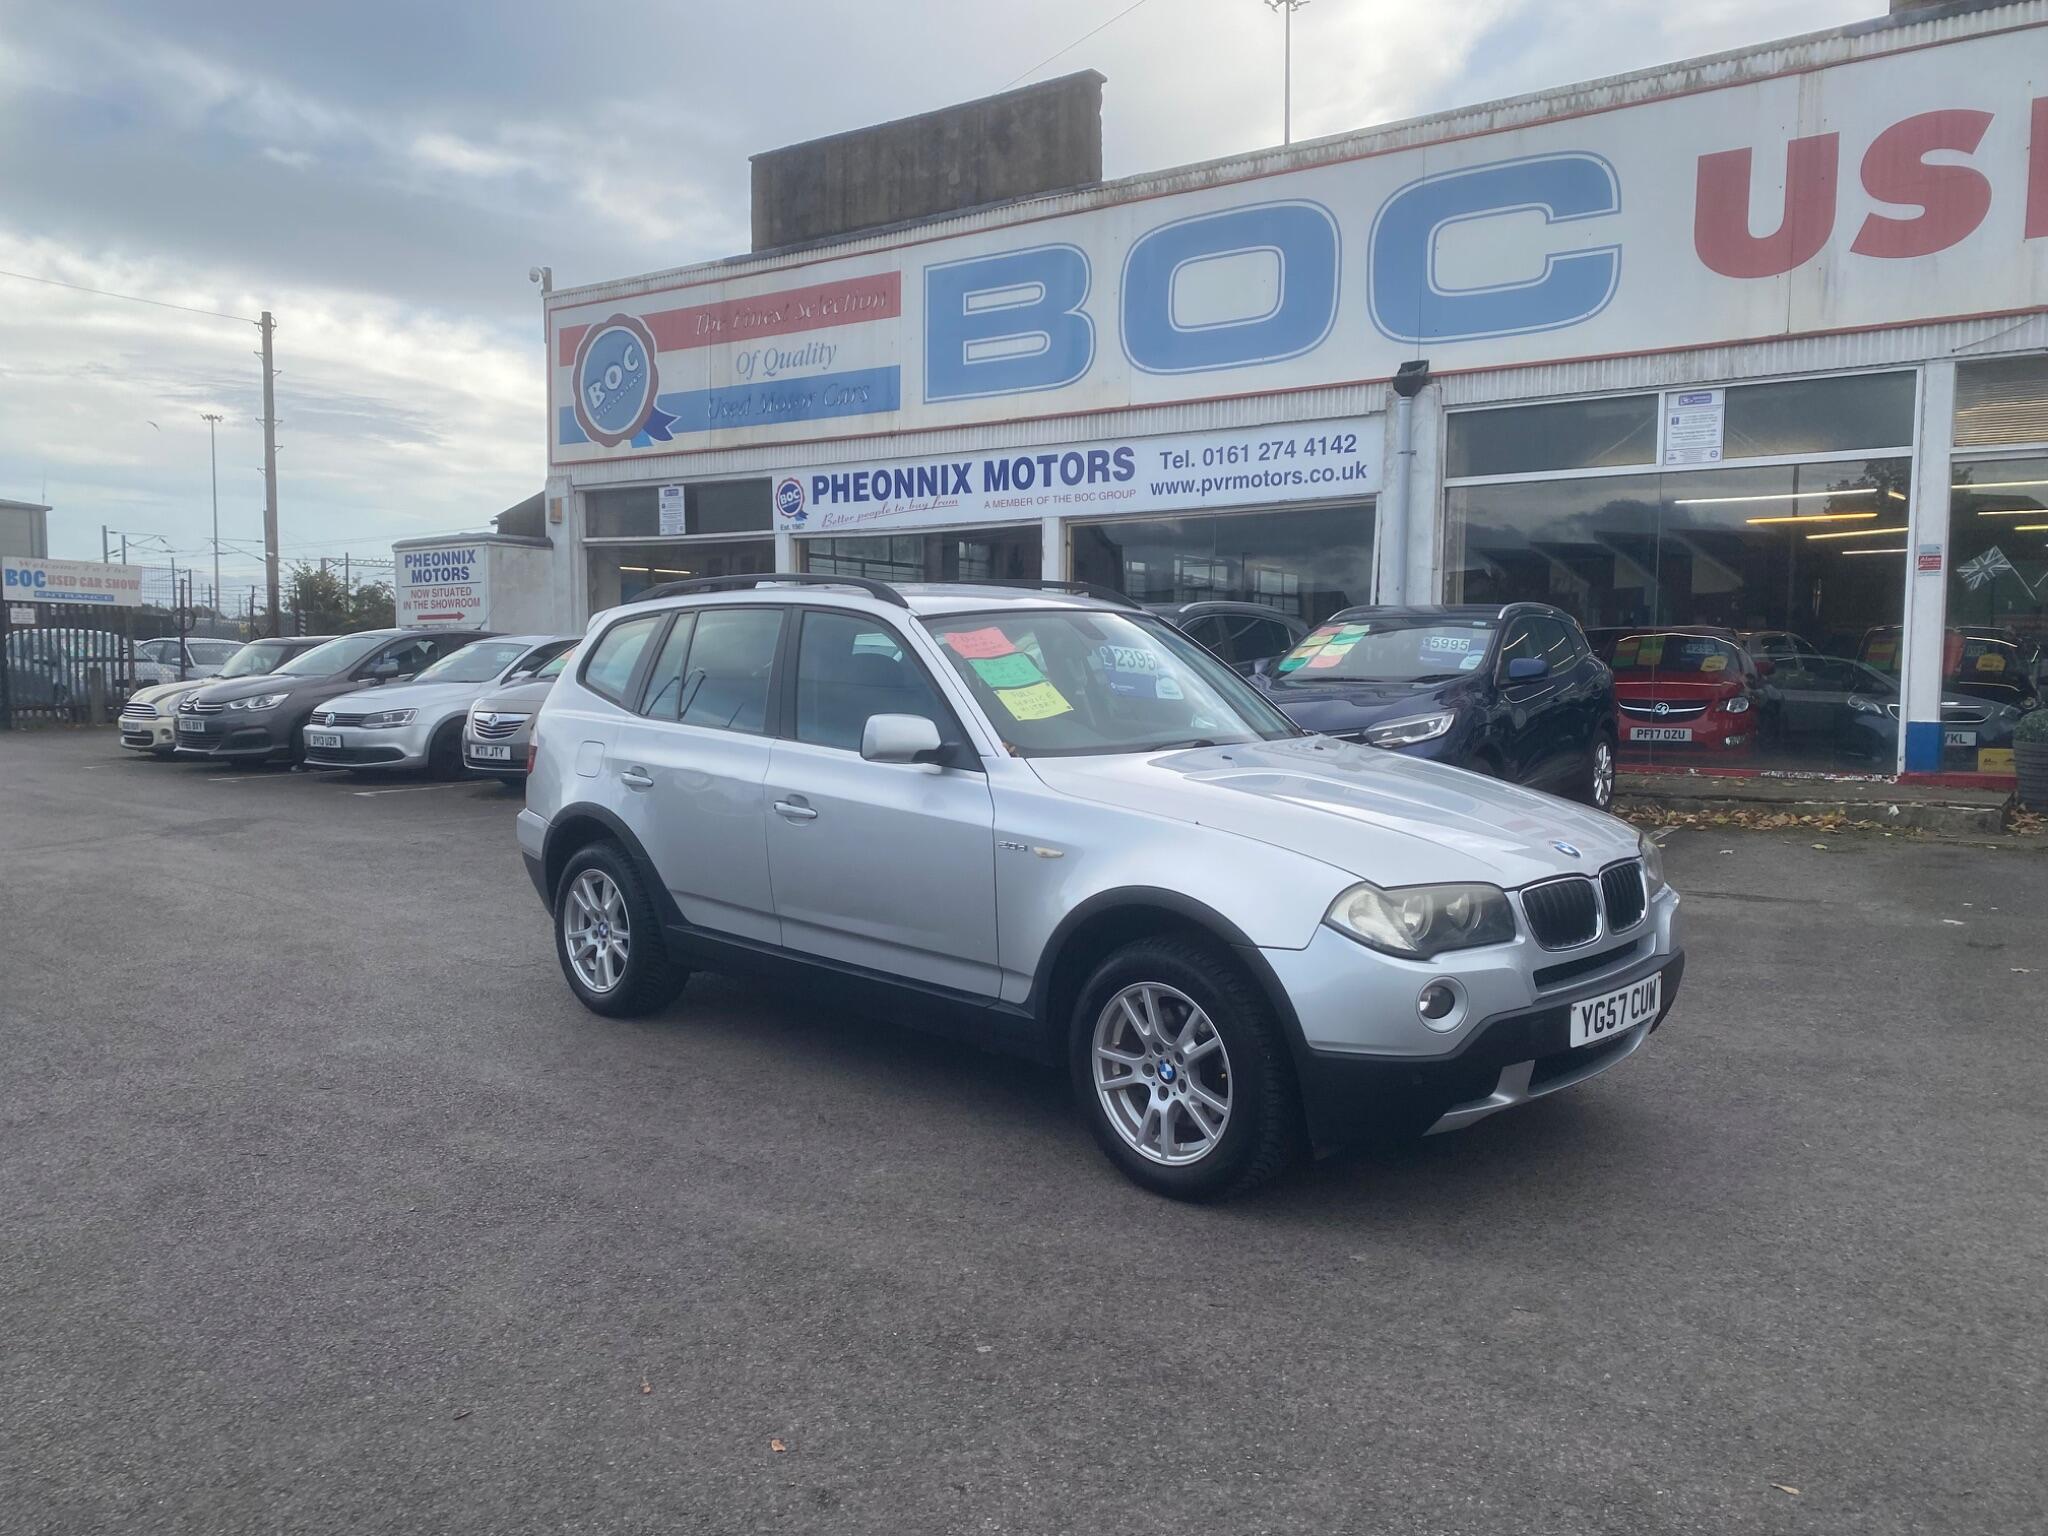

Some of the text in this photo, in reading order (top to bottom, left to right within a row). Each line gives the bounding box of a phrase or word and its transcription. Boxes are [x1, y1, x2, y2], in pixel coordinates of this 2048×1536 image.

[923, 96, 2048, 400] BOC US
[736, 342, 837, 380] Of Quality
[587, 344, 639, 409] BOC
[823, 382, 871, 408] Cars
[1160, 433, 1357, 470] Tel. 0161 274 4142
[812, 446, 1136, 505] PHEONNIX MOTORS
[1150, 460, 1368, 496] www.pvrmotors.co.uk
[780, 488, 800, 504] BOC
[984, 488, 1137, 509] A MEMBER OF THE BOC GROUP
[822, 511, 854, 528] Better
[856, 501, 891, 522] people
[894, 503, 905, 512] to
[931, 495, 959, 510] from
[404, 549, 476, 568] PHEONNIX
[4, 568, 140, 591] BOC USED CAR SHOW
[411, 565, 470, 584] MOTORS
[36, 590, 114, 601] ENTRANCE
[403, 597, 480, 610] IN THE SHOWROOM
[410, 586, 472, 599] NOW SITUATED
[1636, 728, 1661, 739] PF17
[489, 746, 504, 758] JTY
[1582, 993, 1628, 1037] YG57
